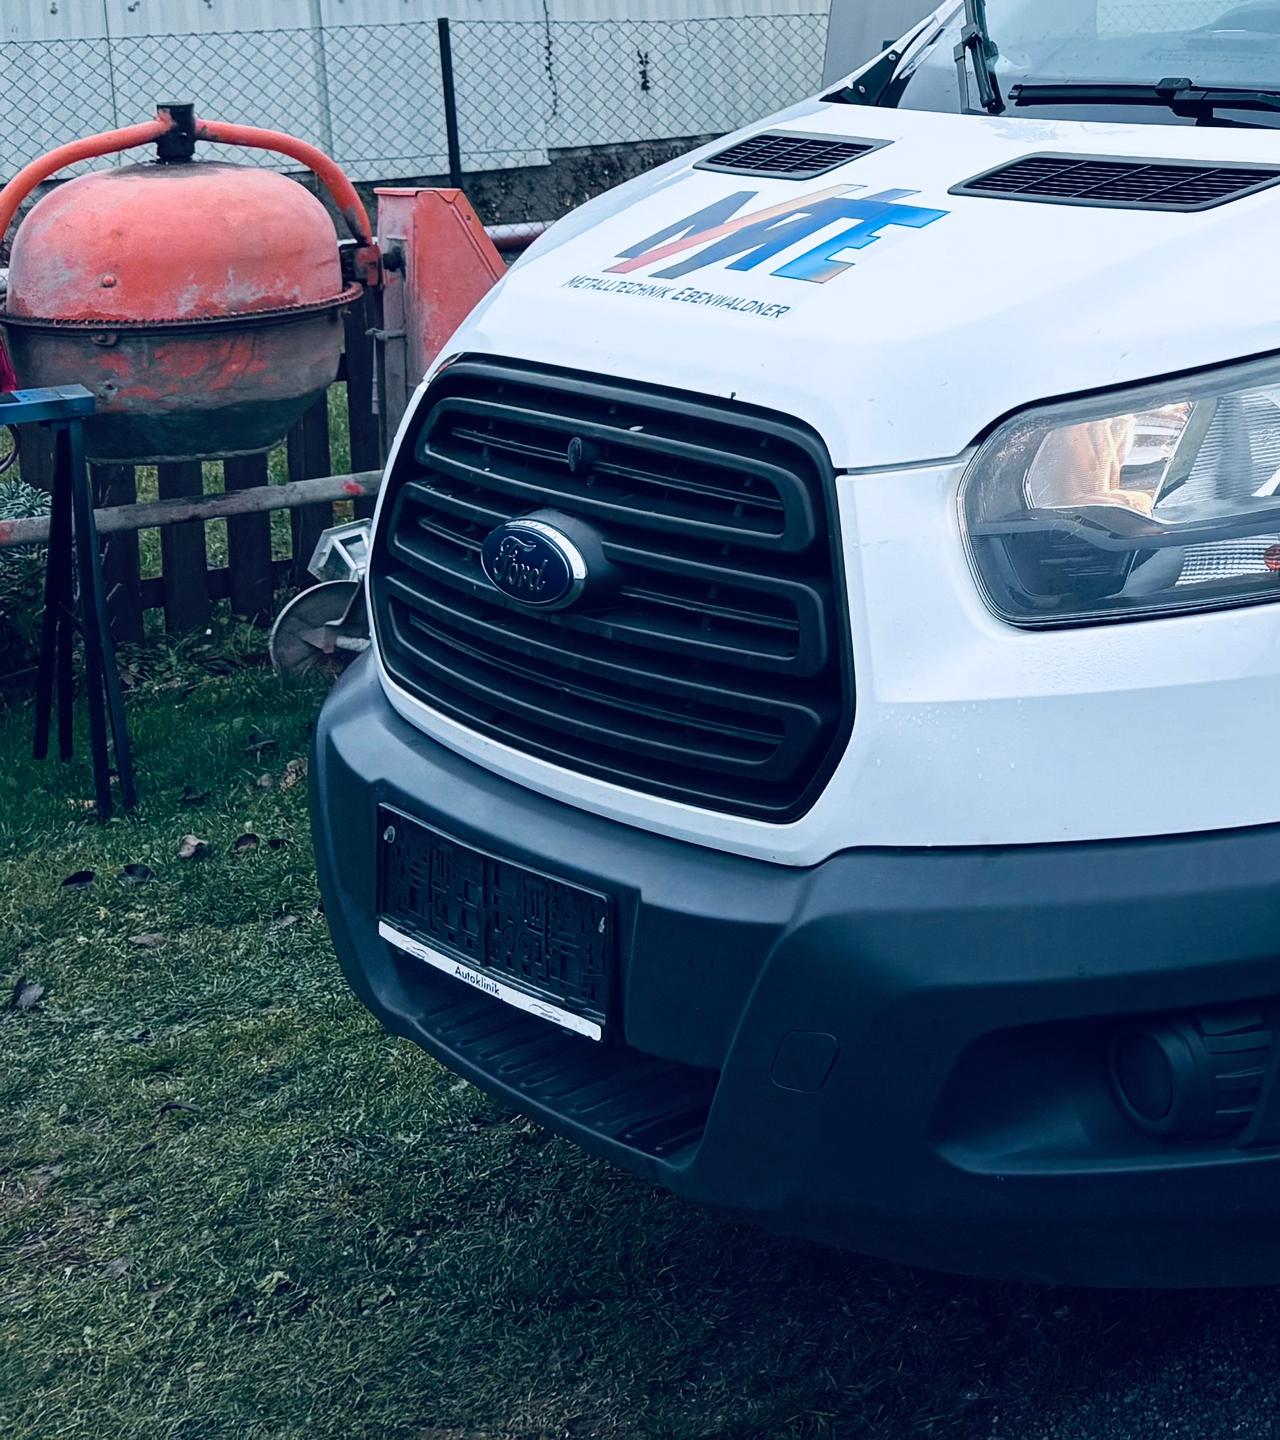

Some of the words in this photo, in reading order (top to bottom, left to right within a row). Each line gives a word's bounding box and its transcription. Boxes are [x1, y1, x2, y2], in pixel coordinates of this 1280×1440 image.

[561, 274, 675, 300] METALLTECHNIK
[671, 286, 791, 319] EBENWALDNER
[494, 536, 548, 591] Ford
[455, 966, 500, 995] Autoklinik
